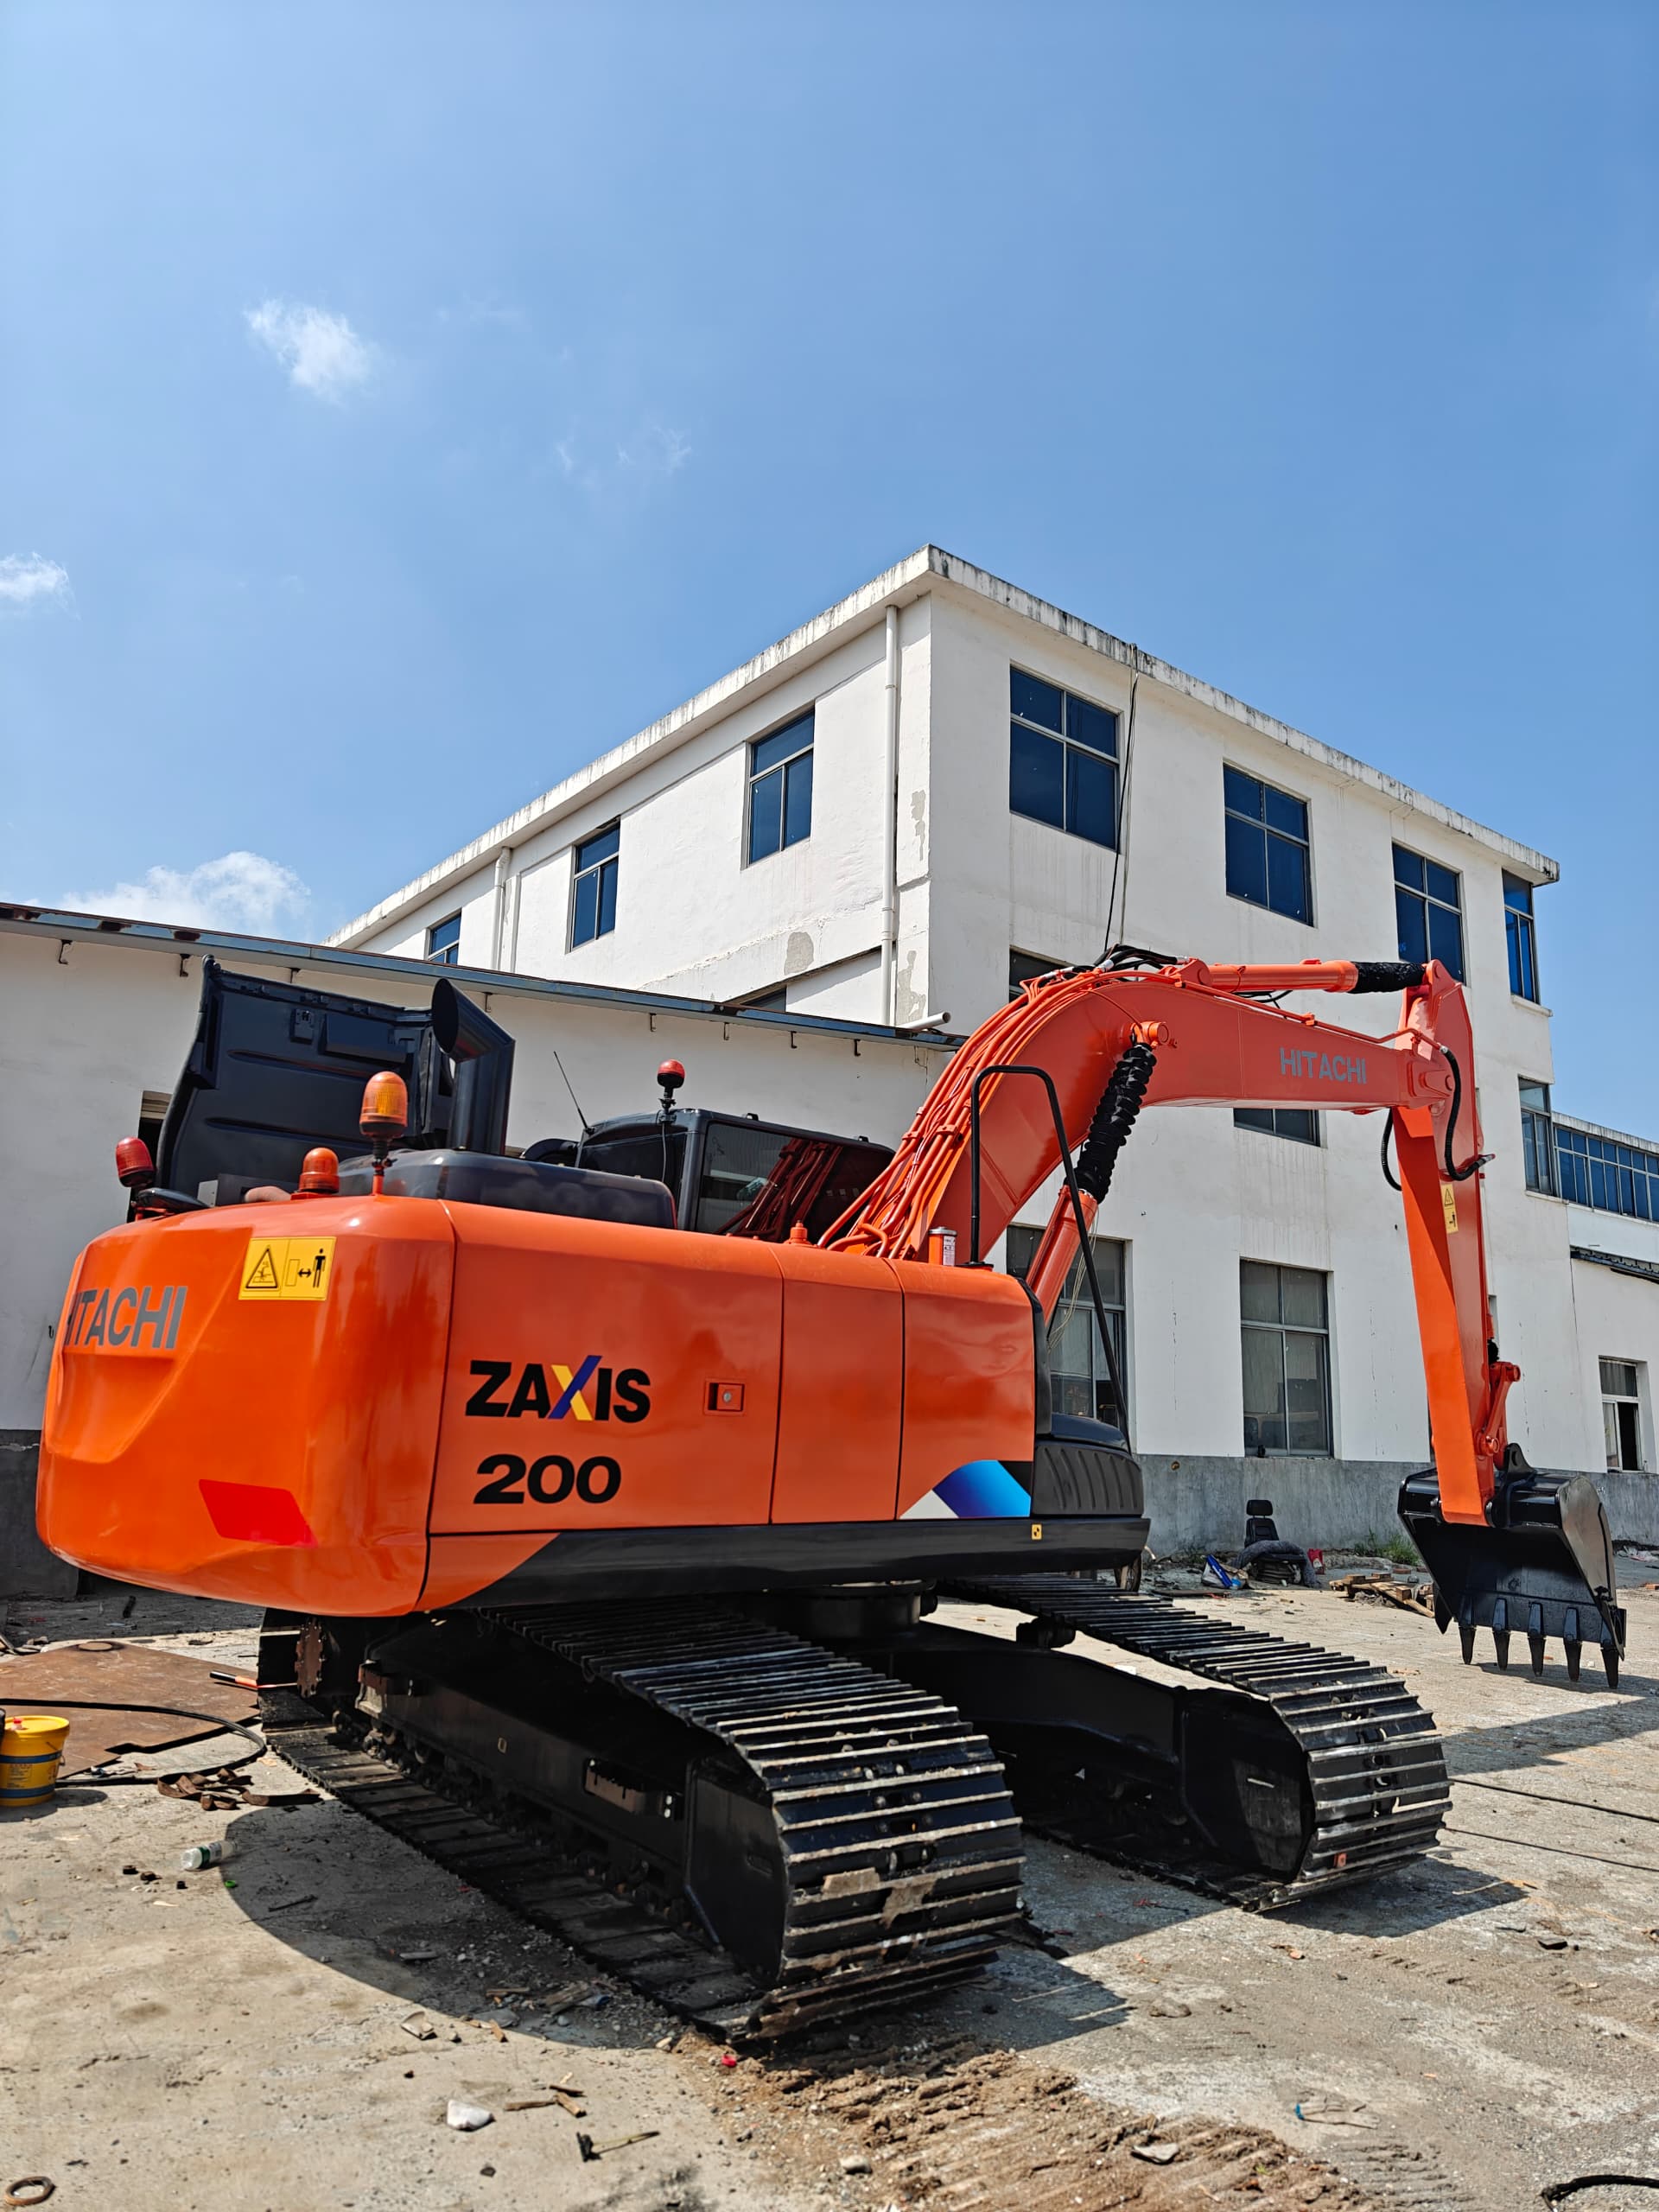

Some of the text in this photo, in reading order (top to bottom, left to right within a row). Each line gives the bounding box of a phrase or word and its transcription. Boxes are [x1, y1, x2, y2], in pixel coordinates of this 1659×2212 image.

[1280, 1046, 1367, 1084] HITACHI
[465, 1355, 651, 1423] ZAXIS
[474, 1454, 622, 1504] 200
